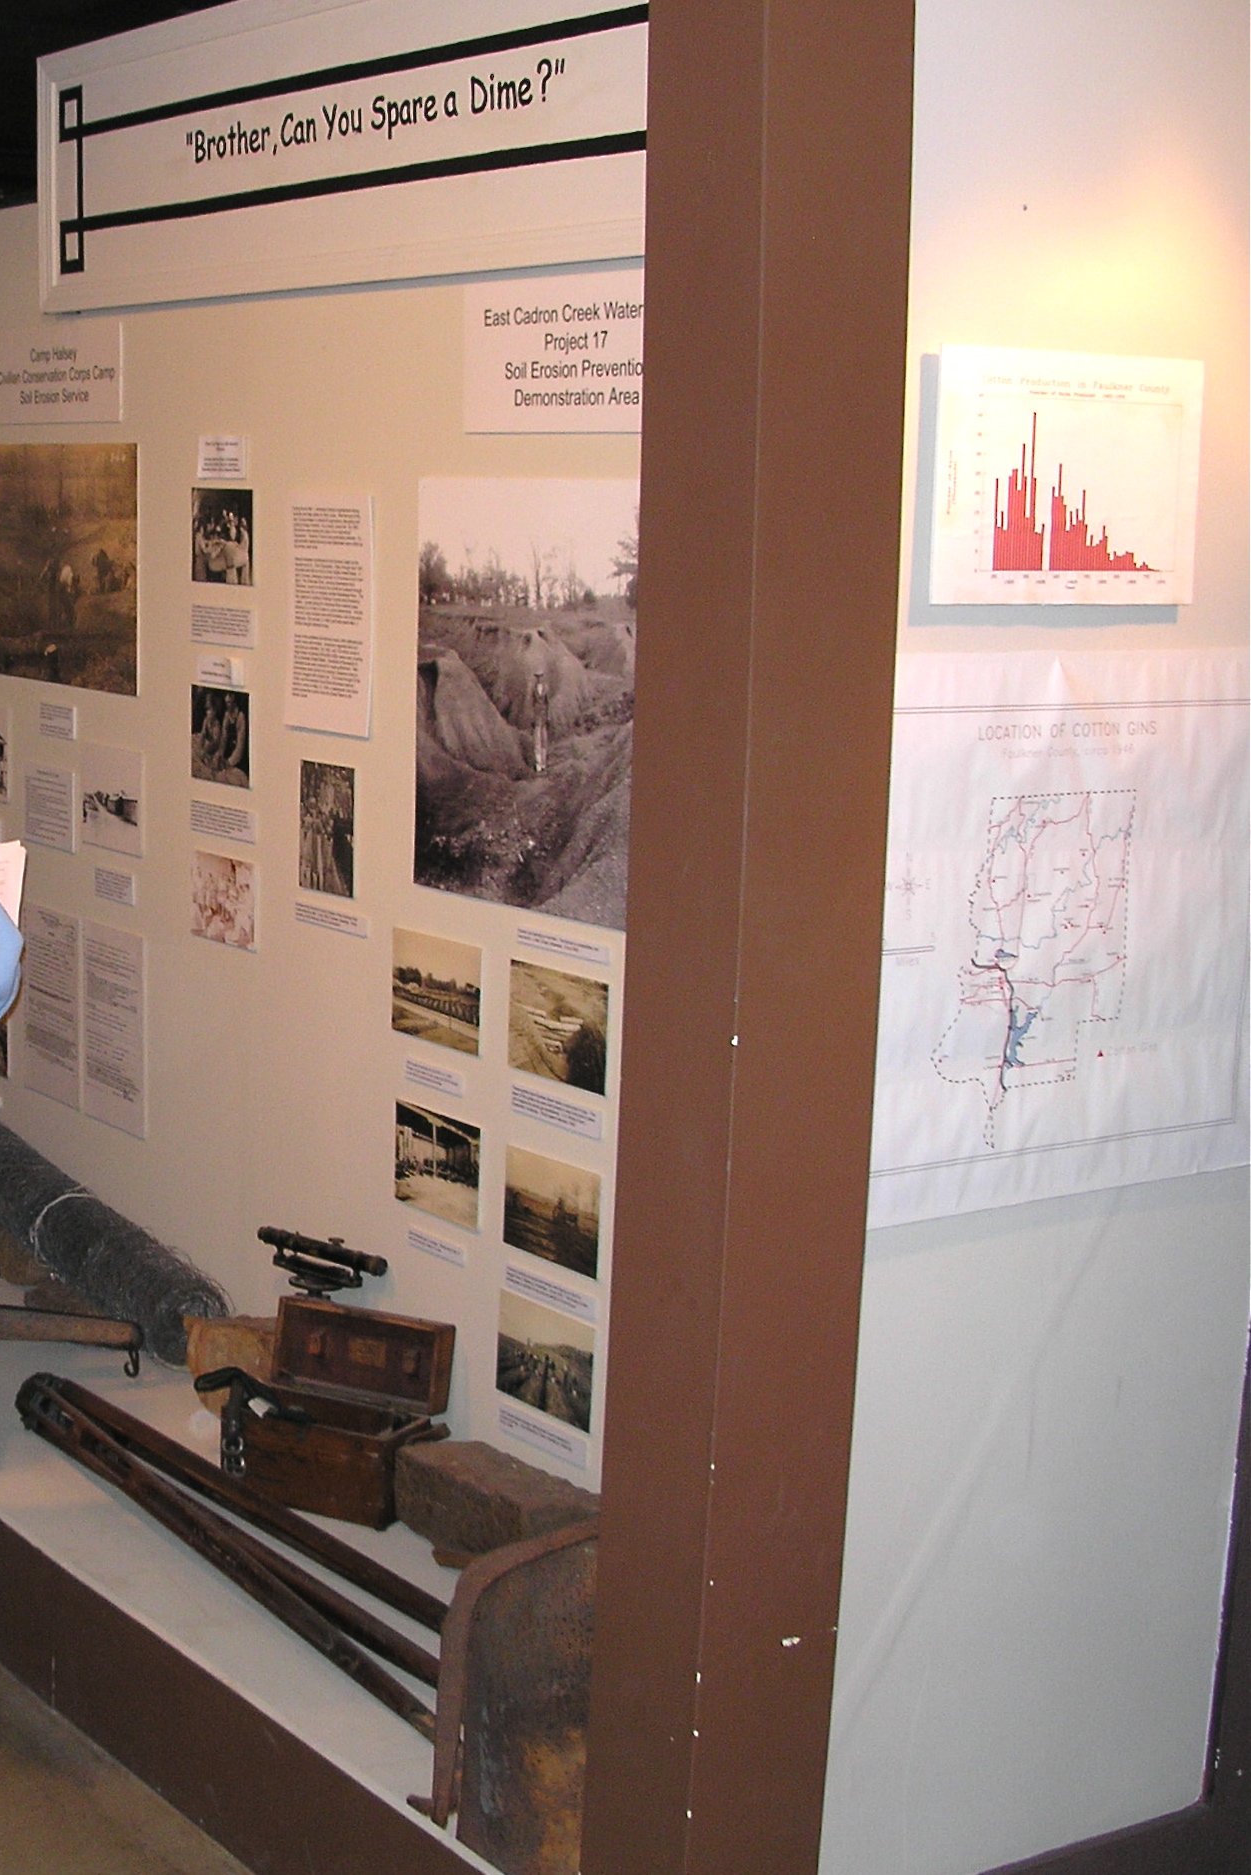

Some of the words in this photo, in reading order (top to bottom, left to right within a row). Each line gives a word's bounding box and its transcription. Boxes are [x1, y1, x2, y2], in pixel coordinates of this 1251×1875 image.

[186, 120, 278, 165] "Brother,
[280, 113, 317, 147] Can
[322, 103, 362, 140] You
[371, 95, 438, 139] Spare
[444, 91, 458, 117] a
[470, 58, 565, 115] Dime?"
[484, 309, 510, 327] East
[514, 306, 558, 325] Cadron
[562, 303, 600, 323] Creek
[544, 332, 589, 354] Project
[593, 331, 608, 348] 17
[31, 348, 50, 363] Camp
[69, 366, 91, 382] Corps
[92, 365, 115, 382] Camp
[505, 362, 527, 380] Soil
[531, 361, 577, 379] Erosion
[62, 387, 89, 403] Service
[514, 388, 604, 406] Demonstration
[608, 387, 640, 405] Area
[978, 724, 1041, 741] LOCATION
[1050, 723, 1065, 738] OF
[1072, 722, 1120, 738] COTTON
[1128, 721, 1157, 736] GINS
